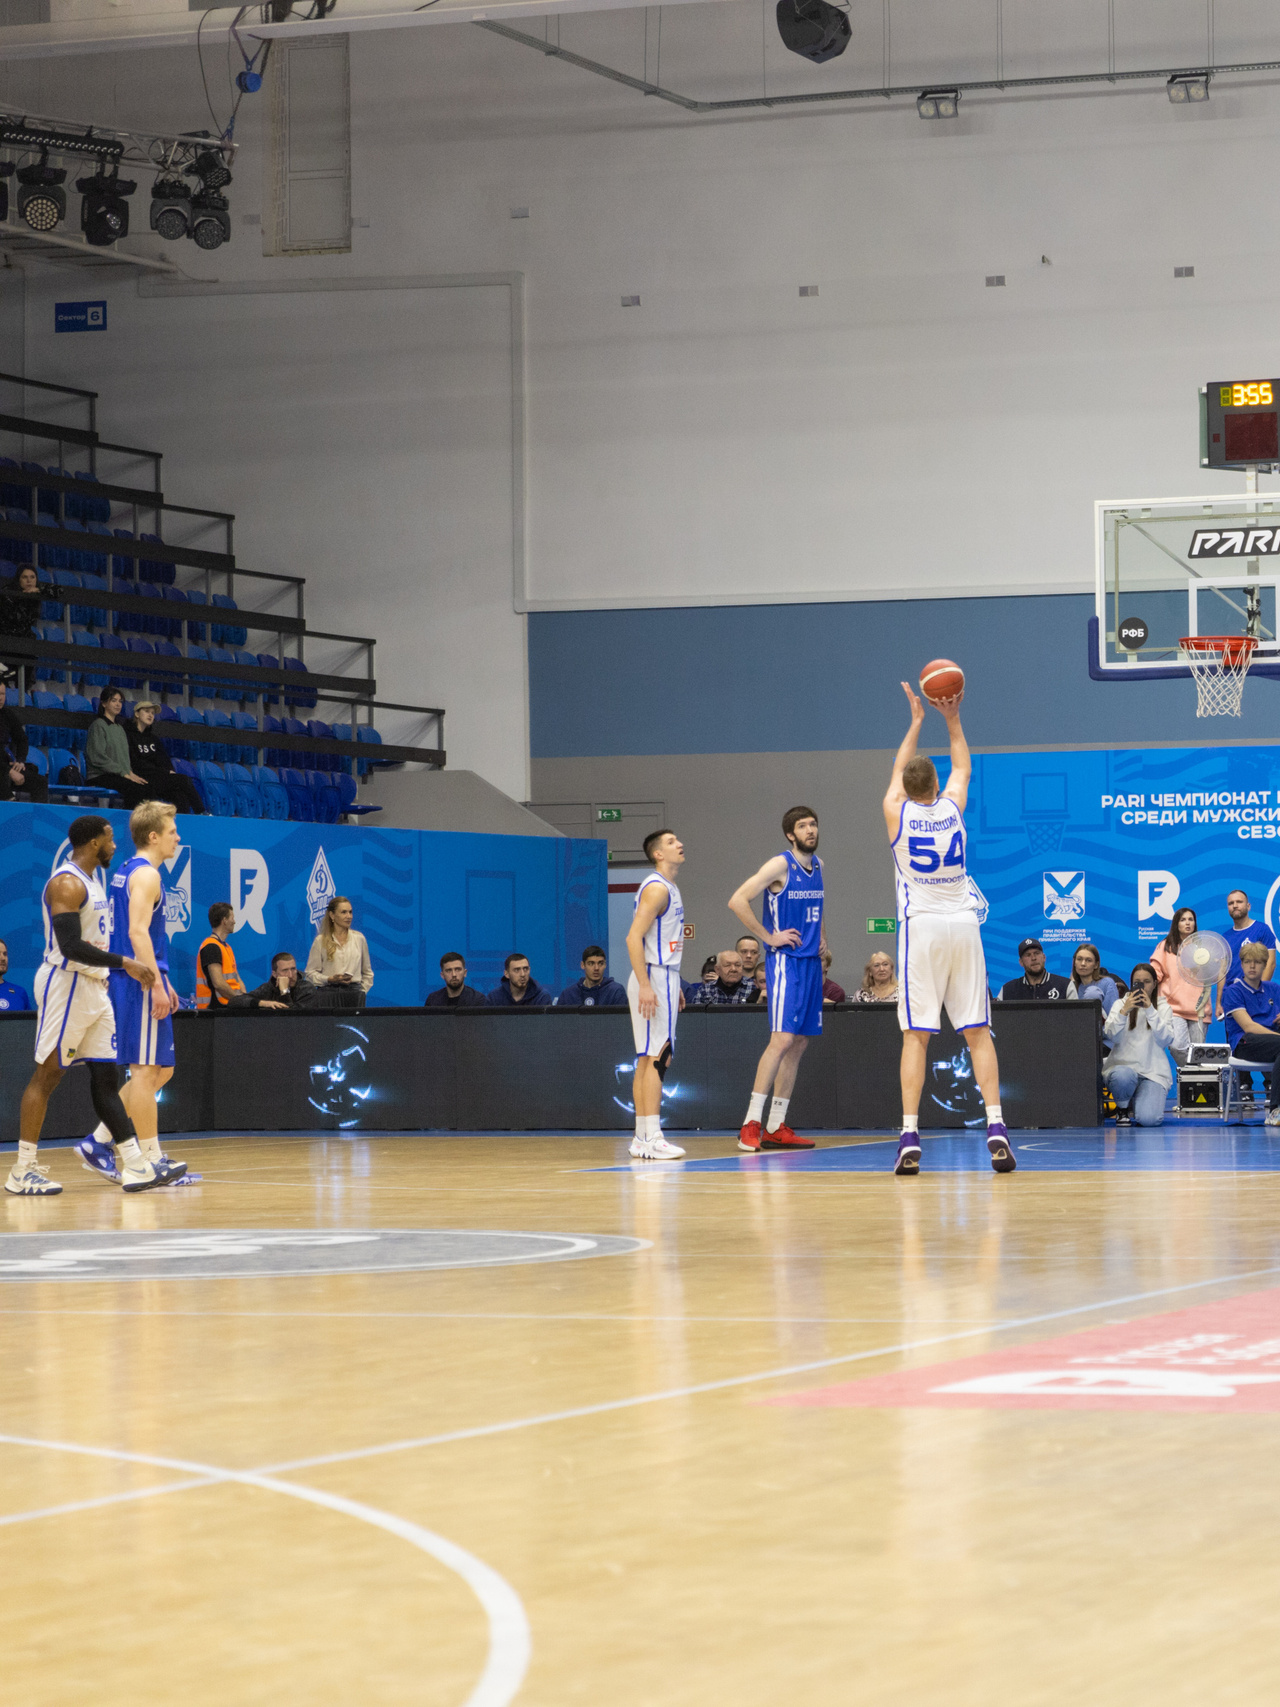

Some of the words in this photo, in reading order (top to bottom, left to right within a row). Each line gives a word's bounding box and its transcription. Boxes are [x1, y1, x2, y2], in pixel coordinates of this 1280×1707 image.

[91, 311, 100, 321] 6
[1122, 628, 1145, 638] РФБ
[1101, 794, 1144, 808] PARI
[1150, 791, 1275, 808] ЧЕМПИОНАТ
[1121, 810, 1187, 826] СРЕДИ
[908, 830, 965, 873] 54
[806, 906, 820, 923] 15
[98, 915, 106, 935] 6
